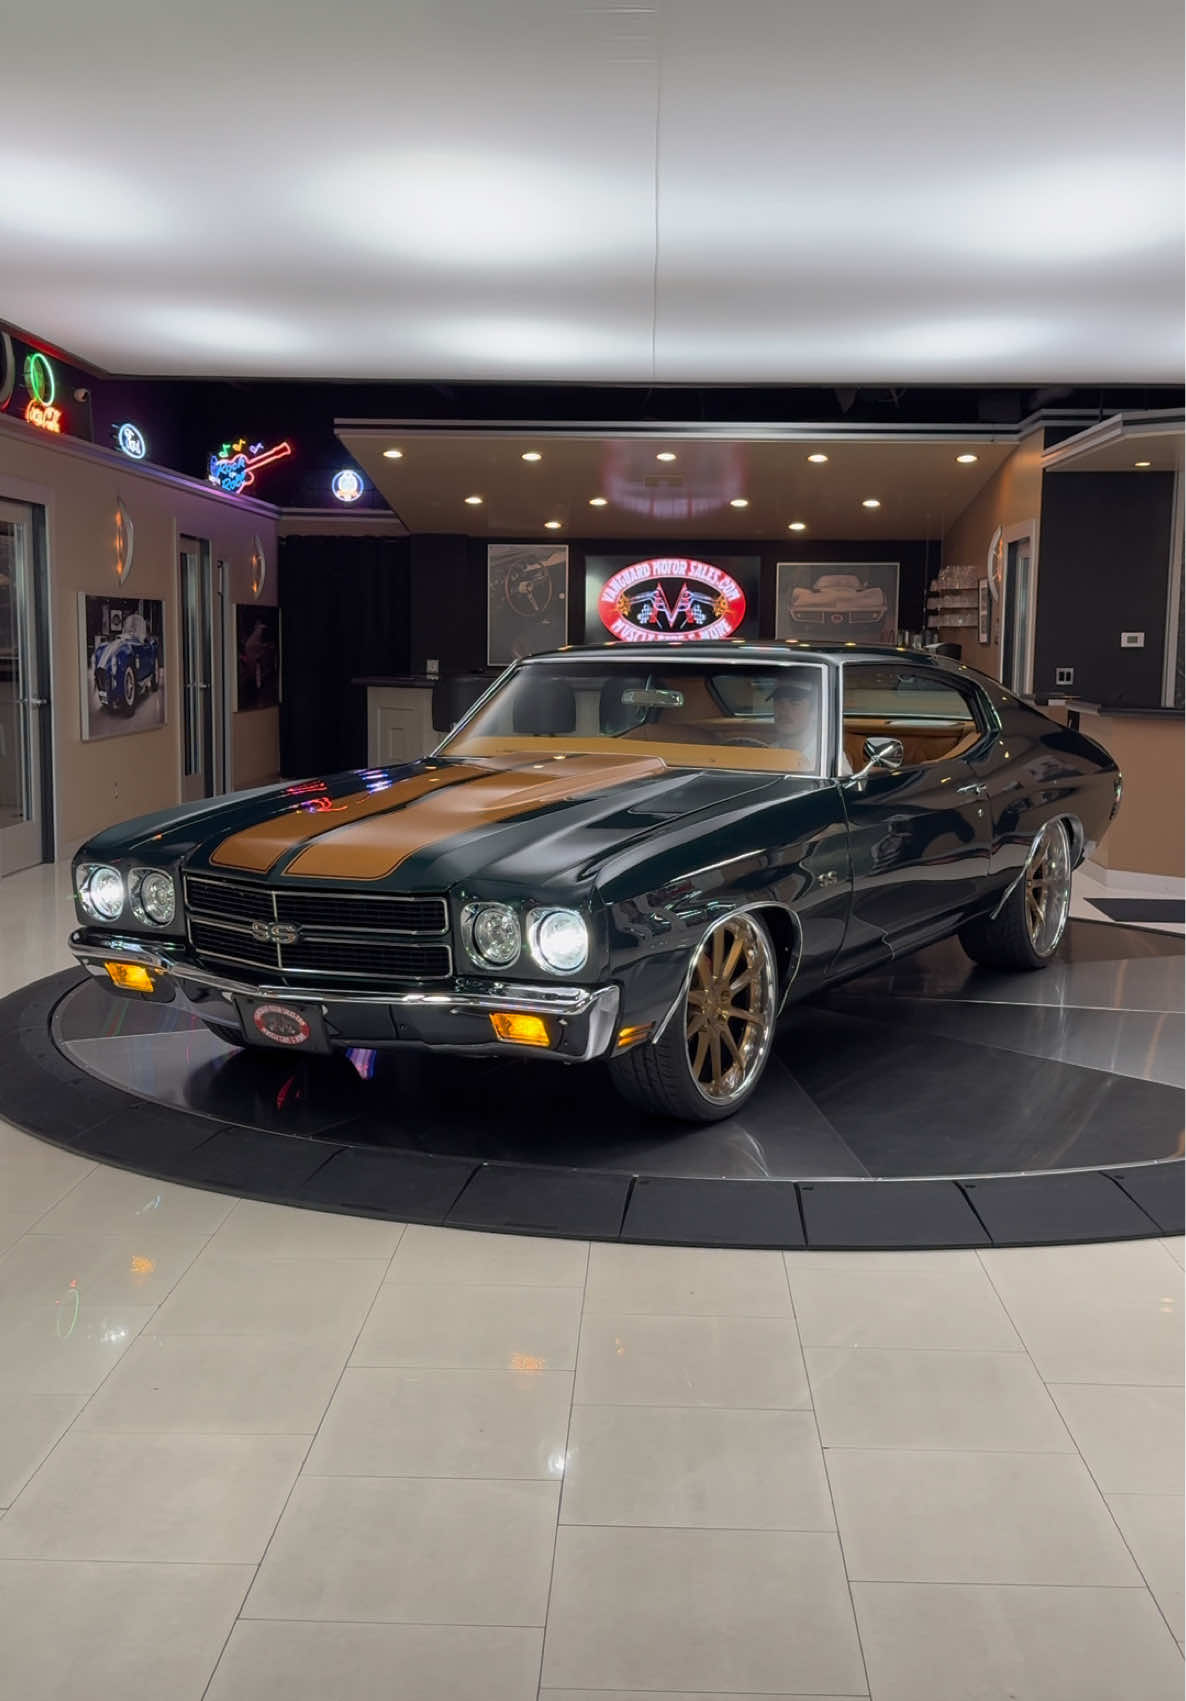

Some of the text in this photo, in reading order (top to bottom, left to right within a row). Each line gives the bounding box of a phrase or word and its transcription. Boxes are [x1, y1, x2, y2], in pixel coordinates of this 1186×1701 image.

[601, 563, 651, 602] VANGUARD
[653, 559, 688, 576] MOTOR
[251, 920, 297, 943] SS
